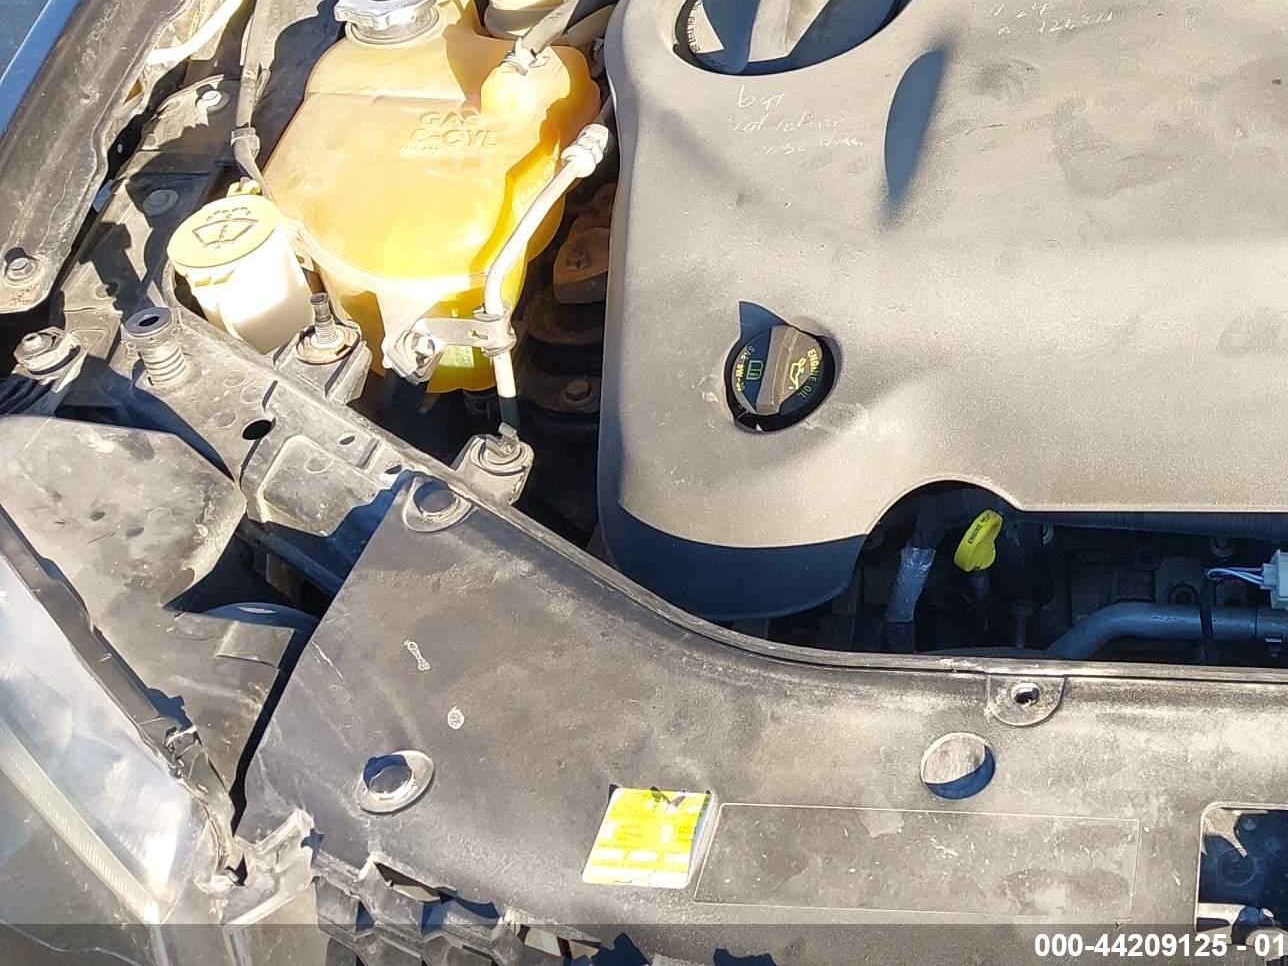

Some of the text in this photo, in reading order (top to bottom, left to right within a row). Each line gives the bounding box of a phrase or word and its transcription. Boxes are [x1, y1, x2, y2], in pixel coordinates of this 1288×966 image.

[740, 345, 755, 360] SAE
[807, 348, 822, 383] ENGINE
[798, 385, 812, 399] OIL
